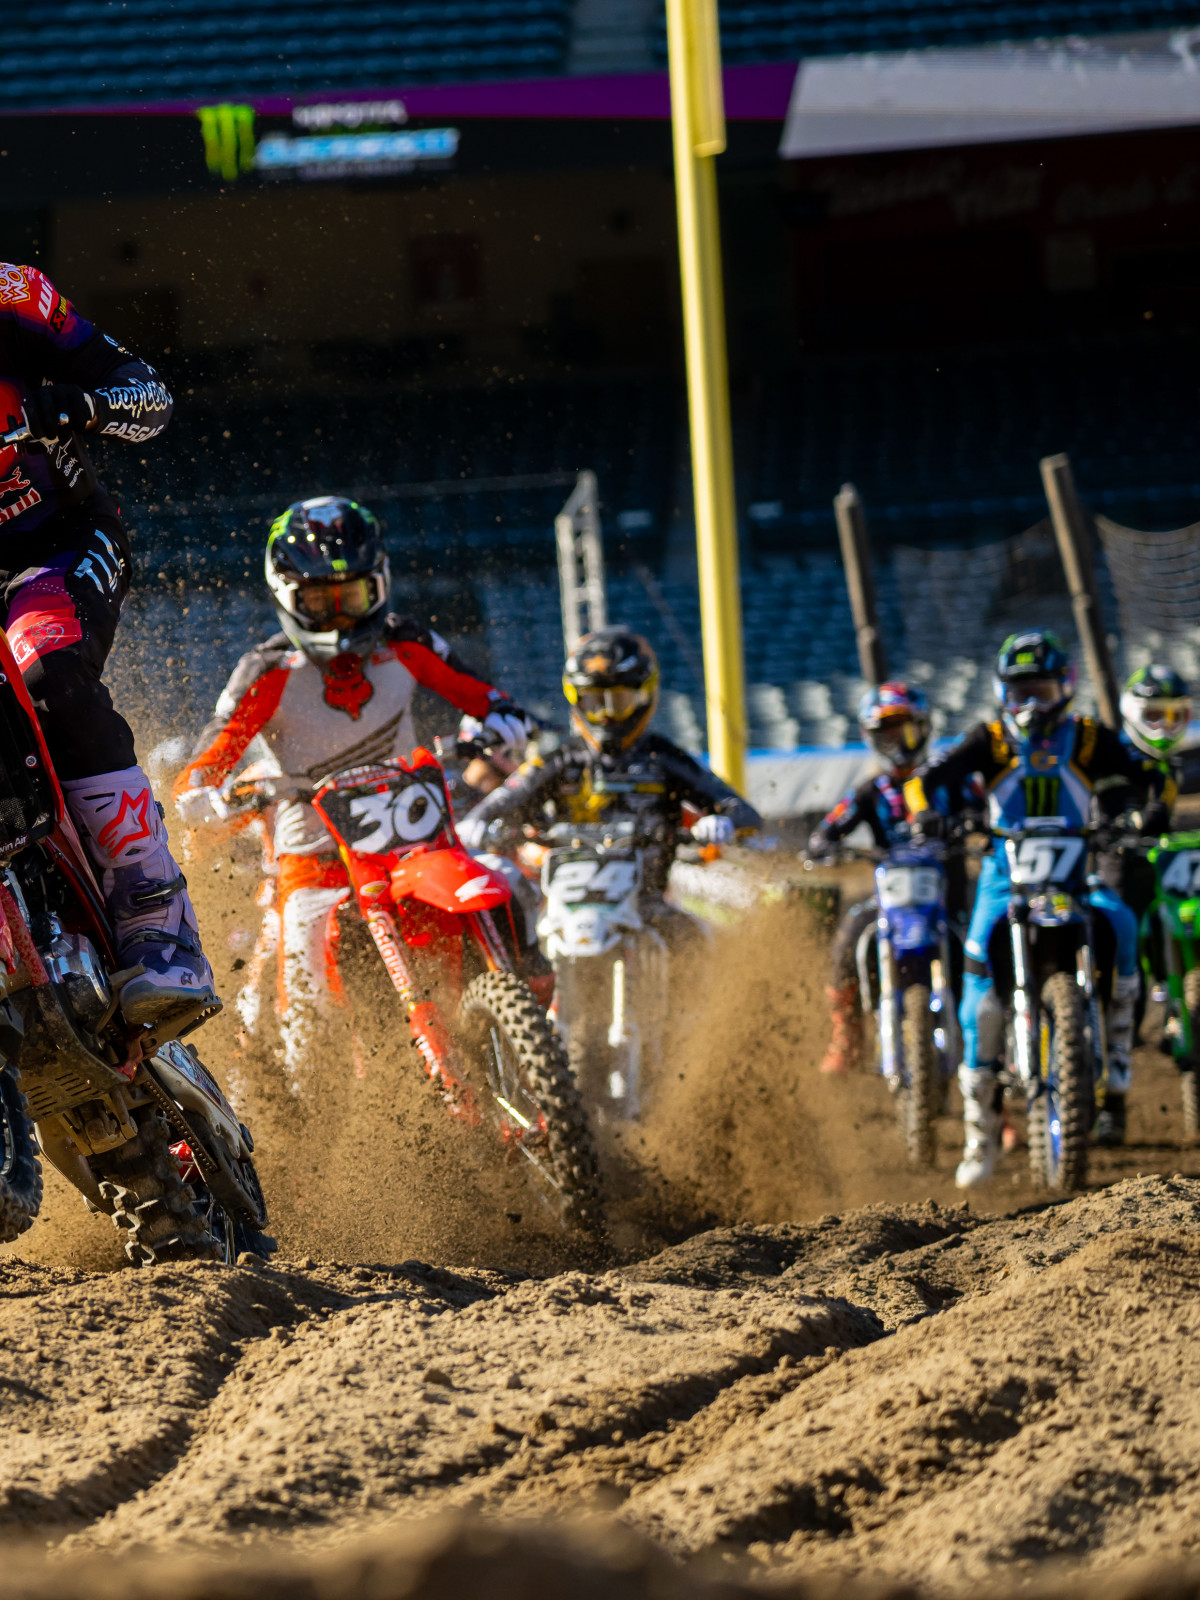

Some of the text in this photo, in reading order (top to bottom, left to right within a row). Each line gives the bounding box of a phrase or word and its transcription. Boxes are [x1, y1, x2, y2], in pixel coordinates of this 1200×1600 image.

[351, 782, 445, 854] 30
[13, 834, 28, 849] Air
[1016, 838, 1084, 882] 57
[555, 860, 636, 901] 24
